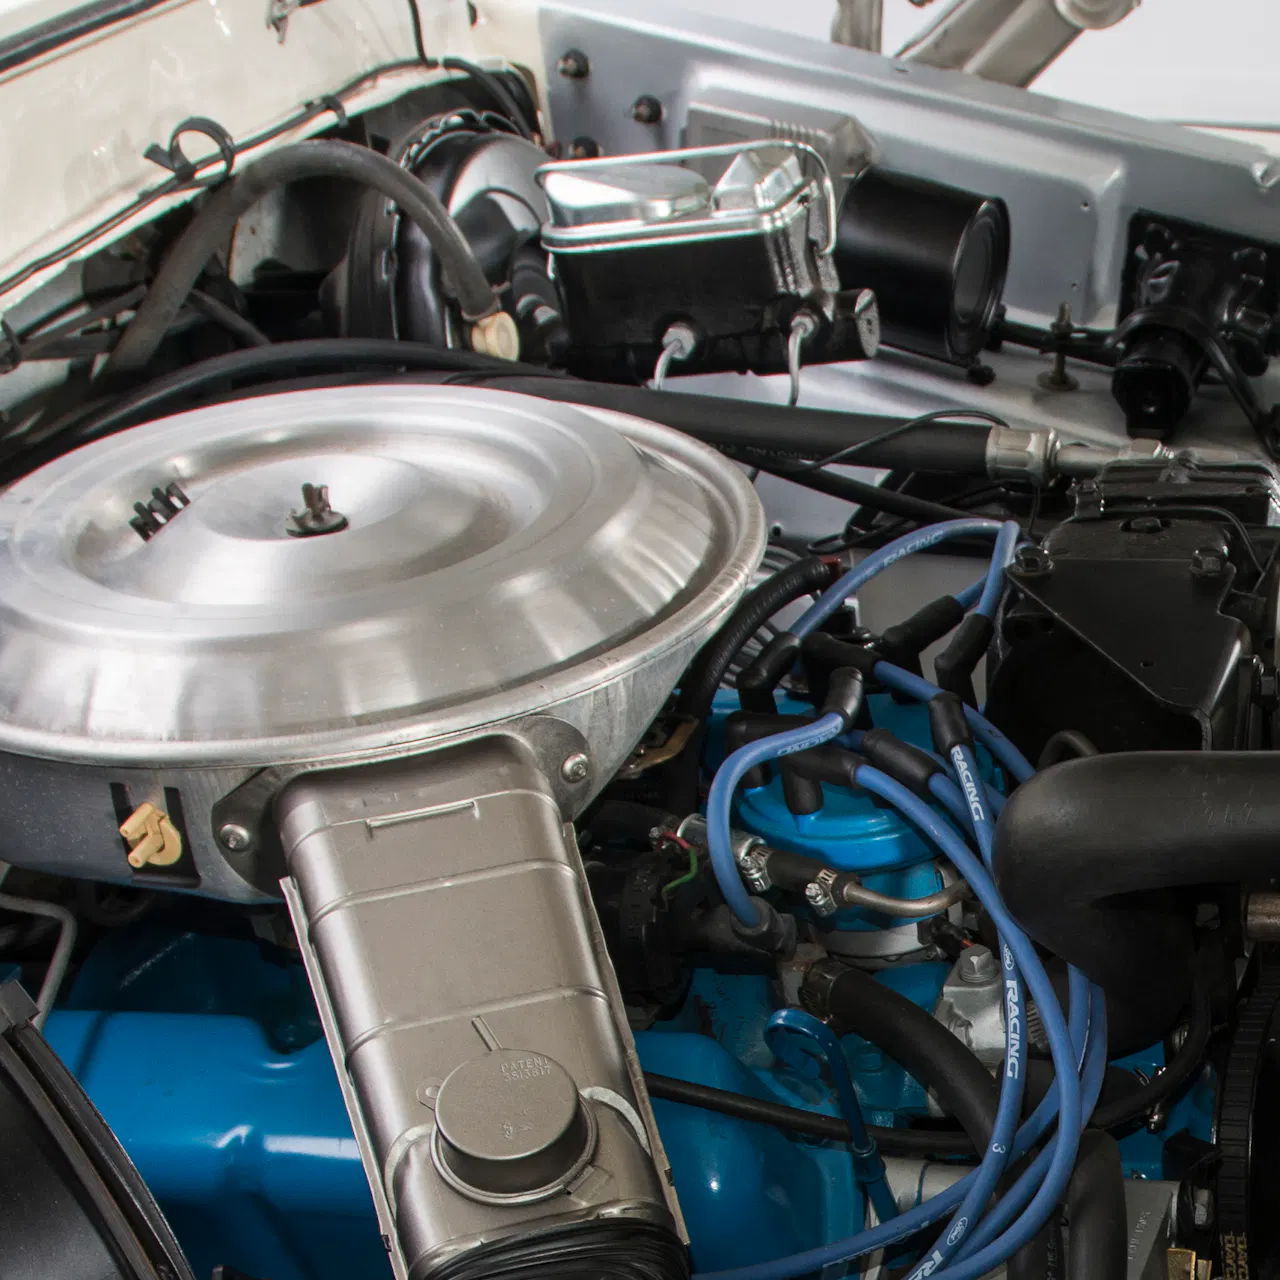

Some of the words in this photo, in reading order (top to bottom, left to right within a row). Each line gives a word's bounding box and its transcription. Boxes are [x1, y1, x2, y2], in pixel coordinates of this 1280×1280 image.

[950, 744, 985, 822] RACING
[1006, 979, 1021, 1080] RACING
[992, 1142, 1007, 1155] 3
